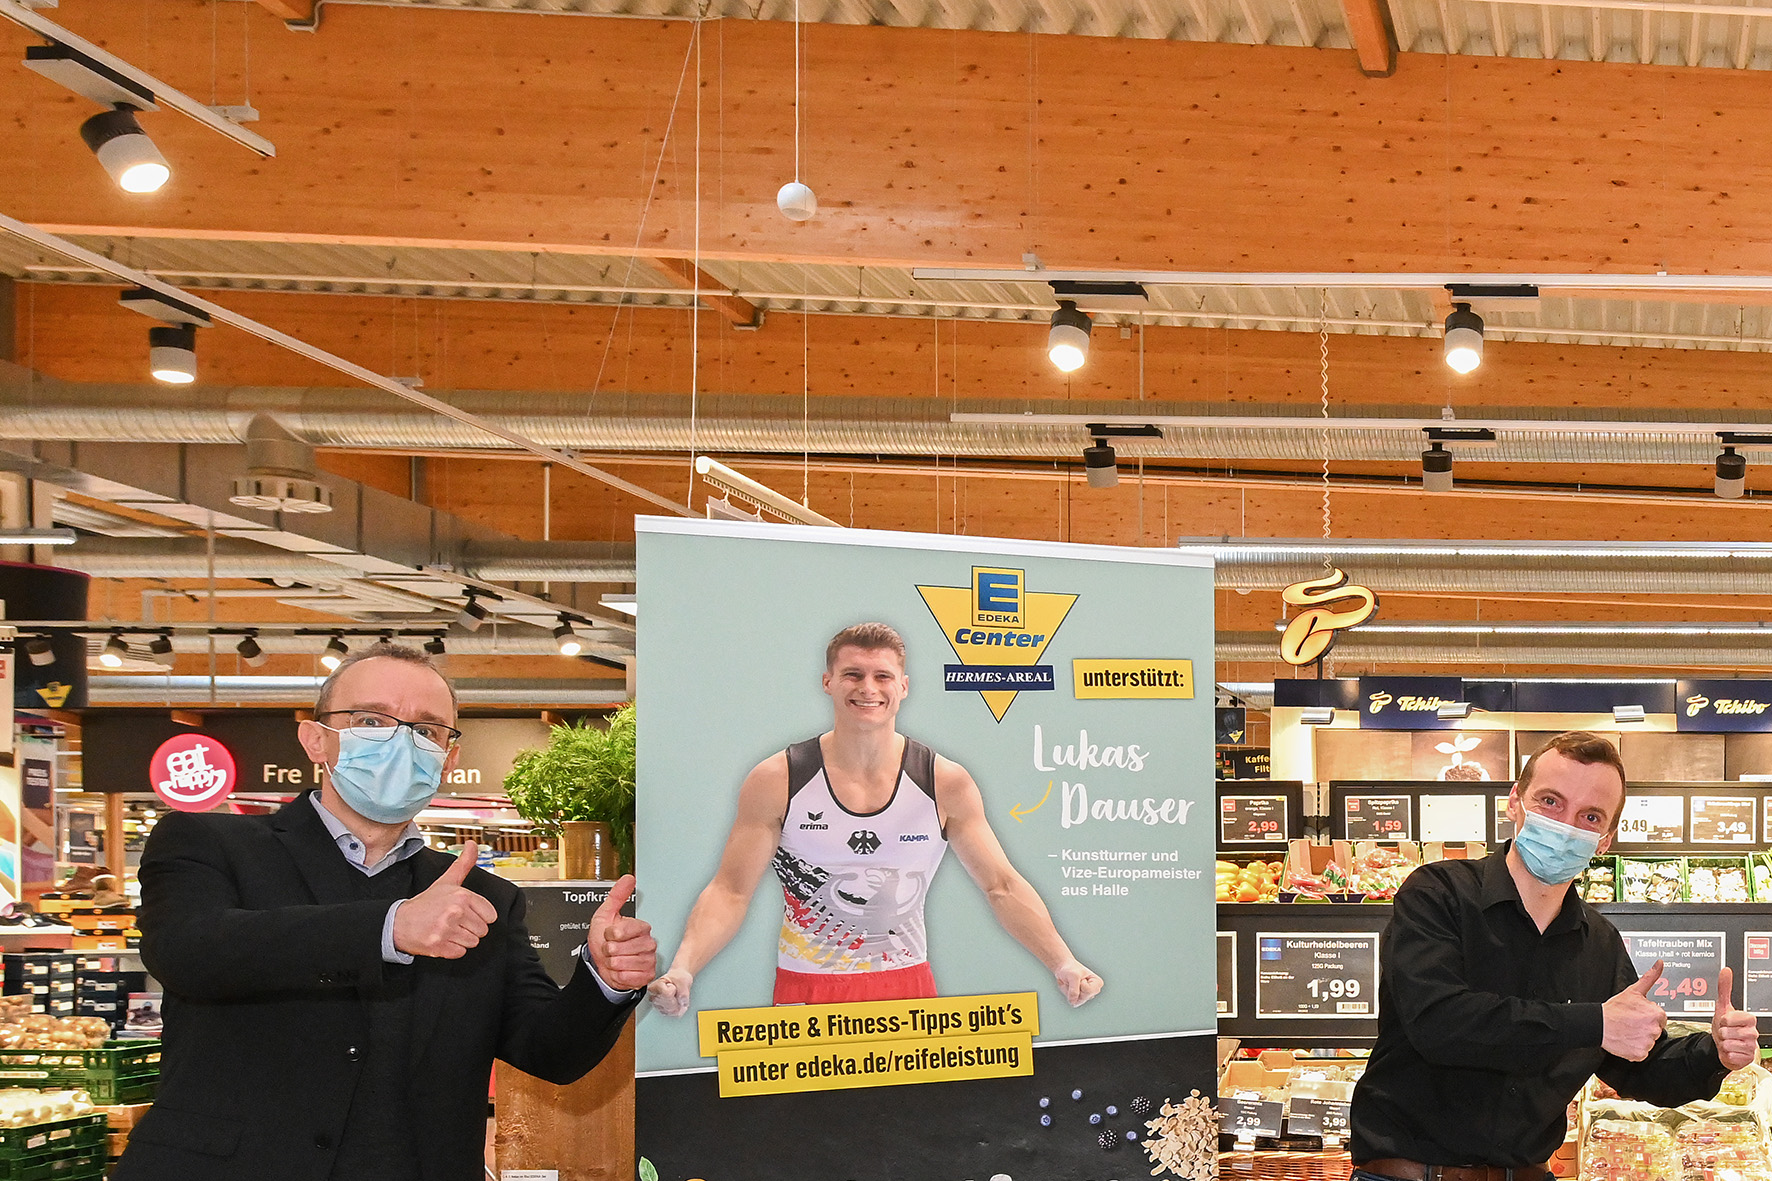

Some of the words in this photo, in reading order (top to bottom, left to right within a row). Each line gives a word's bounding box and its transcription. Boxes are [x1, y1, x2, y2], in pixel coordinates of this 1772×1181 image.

[978, 614, 1019, 623] EDEKA
[955, 628, 1045, 647] Center
[946, 672, 1051, 682] HERMES-AREAL
[1084, 669, 1184, 687] unterstützt:
[1714, 700, 1771, 714] Tchibo
[1034, 724, 1149, 771] Lukas
[166, 744, 214, 776] eat
[169, 770, 217, 790] happy
[1061, 781, 1195, 828] Dauser
[1249, 821, 1278, 833] 2,99
[1373, 821, 1401, 832] 1,59
[1717, 822, 1746, 834] 3,49
[1062, 849, 1147, 861] Kunstturner
[1151, 851, 1178, 861] und
[1062, 867, 1201, 880] Vize-Europameister
[1061, 886, 1087, 896] aus
[1093, 884, 1129, 896] Halle
[1286, 941, 1368, 949] Kulturheidelbeeren
[1638, 939, 1694, 948] Tafeltrauben
[1697, 939, 1713, 948] Mix
[1307, 979, 1360, 1002] 1,99
[1654, 978, 1707, 1000] 2,49
[717, 1020, 800, 1046] Rezepte
[807, 1016, 821, 1037] &
[828, 1008, 962, 1036] Fitness-Tipps
[733, 1061, 788, 1083] unter
[796, 1046, 1019, 1079] edeka.de/reifeleistung
[1323, 1117, 1346, 1127] 3,99
